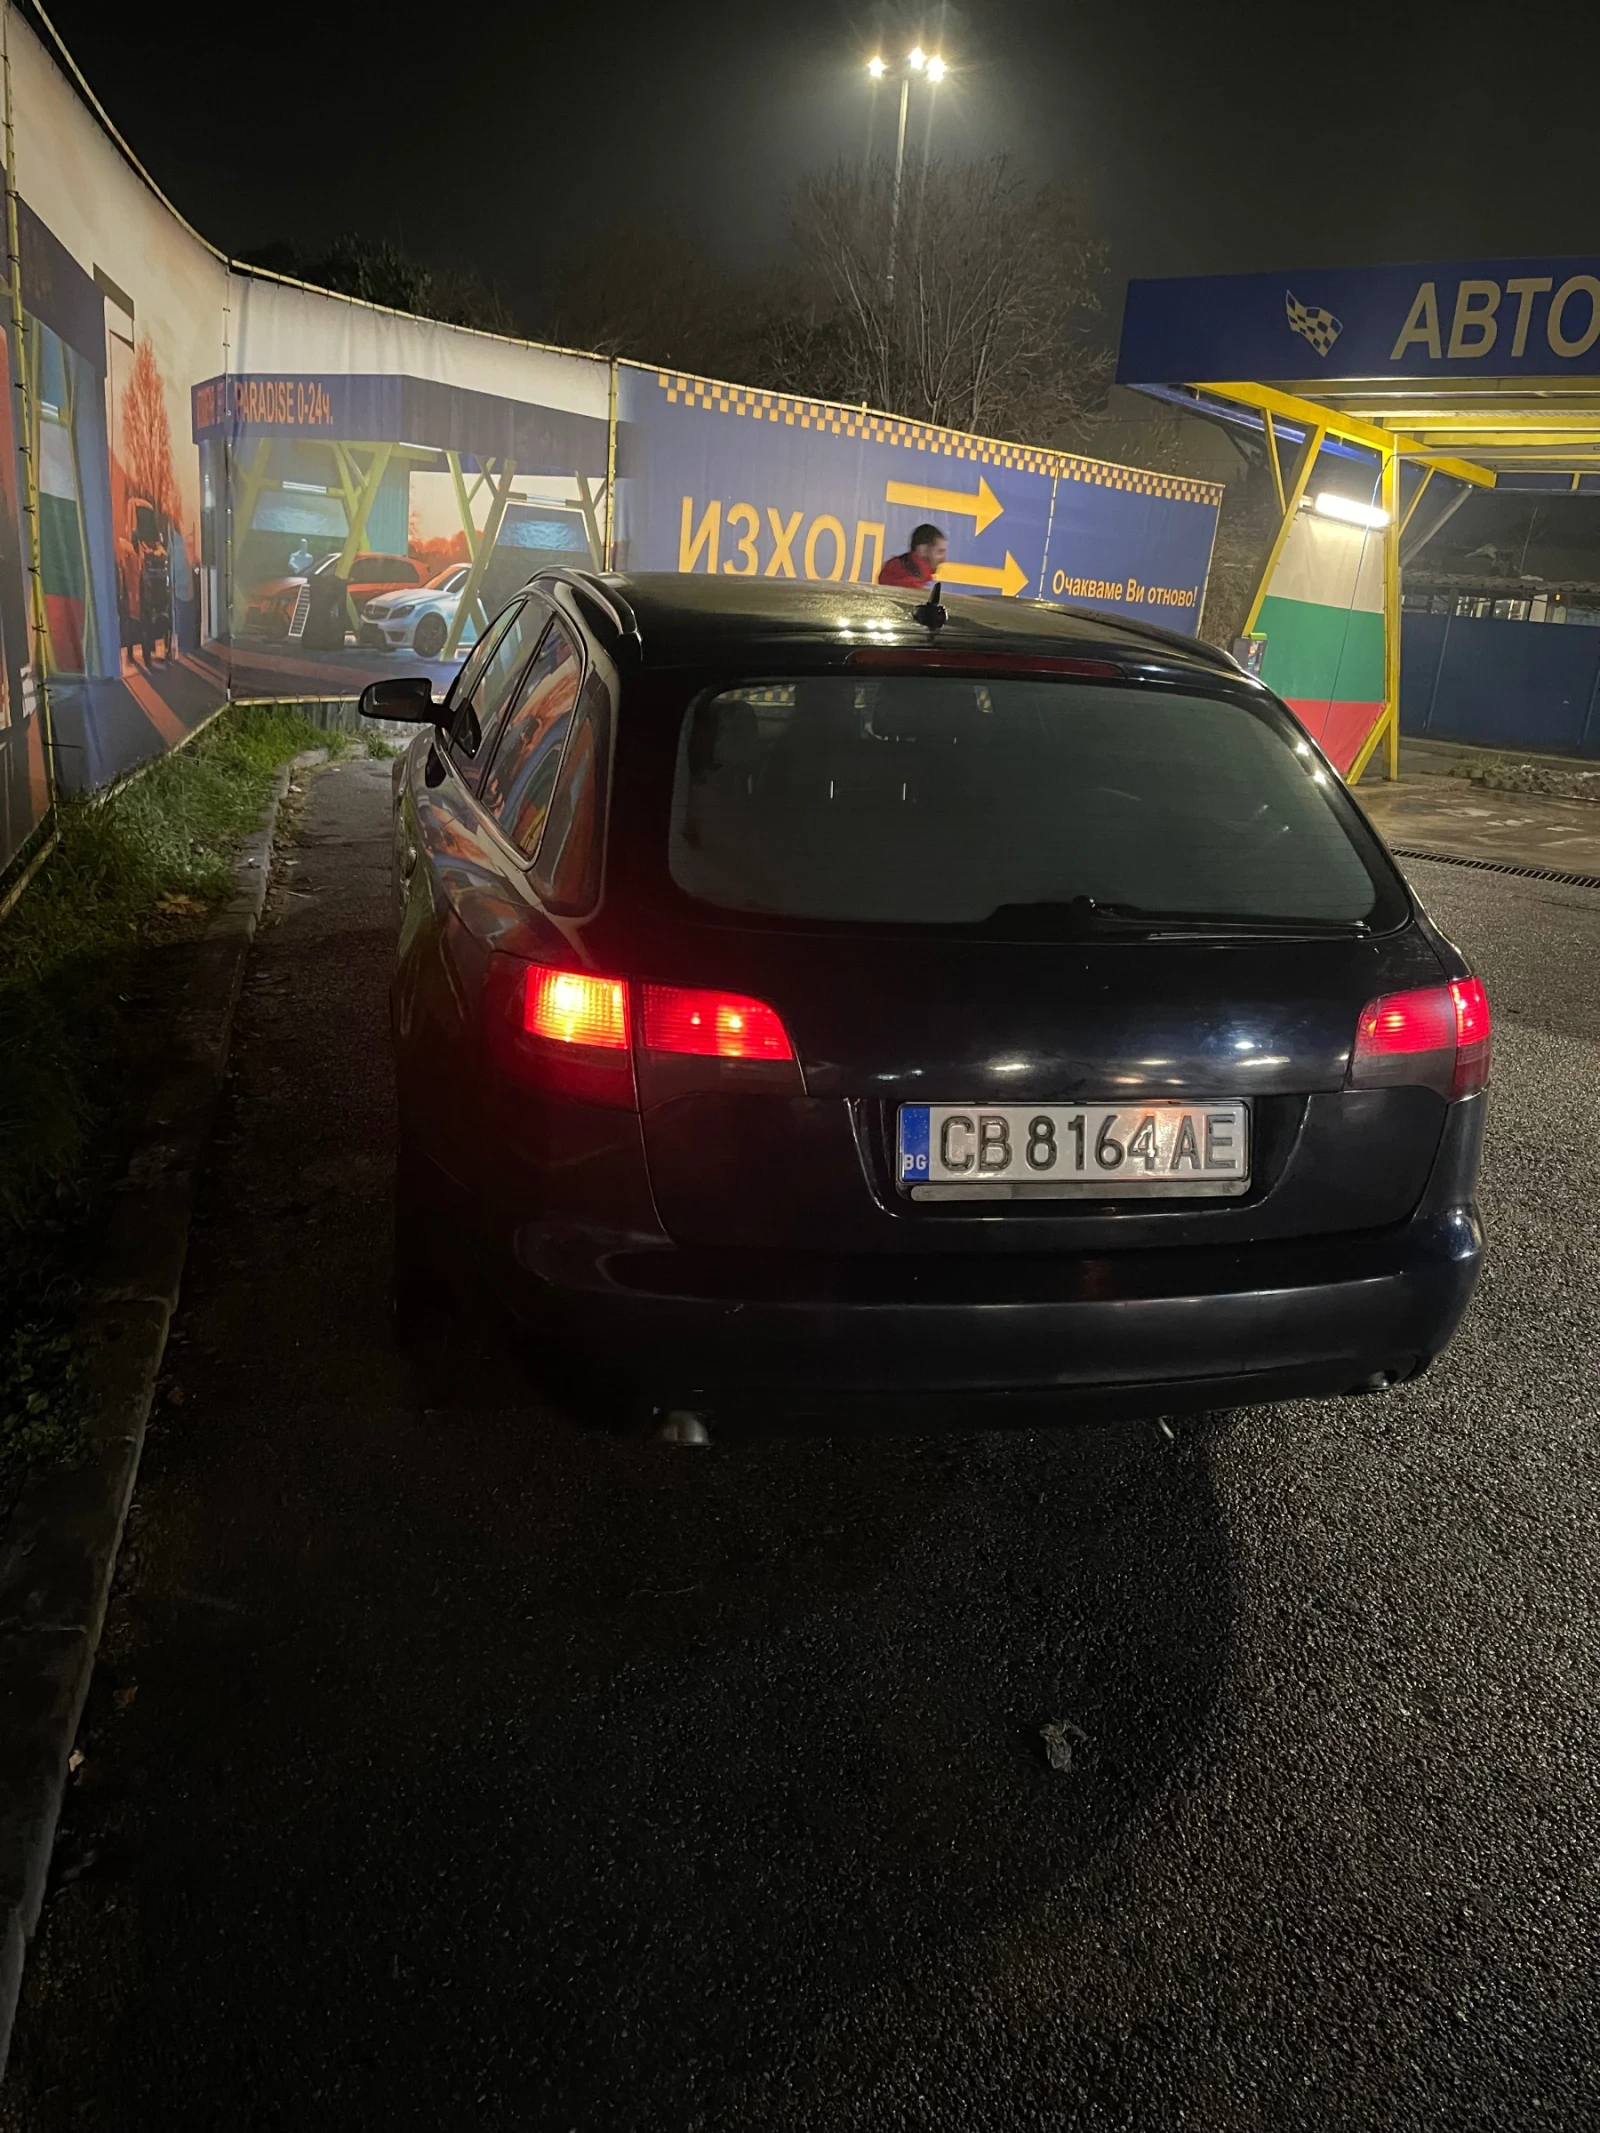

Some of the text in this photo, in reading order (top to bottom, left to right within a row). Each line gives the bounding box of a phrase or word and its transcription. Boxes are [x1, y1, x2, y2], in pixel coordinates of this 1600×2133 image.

[1390, 275, 1600, 360] АВТО
[234, 381, 294, 424] PARADISE
[1052, 569, 1198, 608] Очакваме Ви отново!
[903, 1153, 928, 1171] BG
[940, 1114, 1237, 1172] CB 8164 AE
